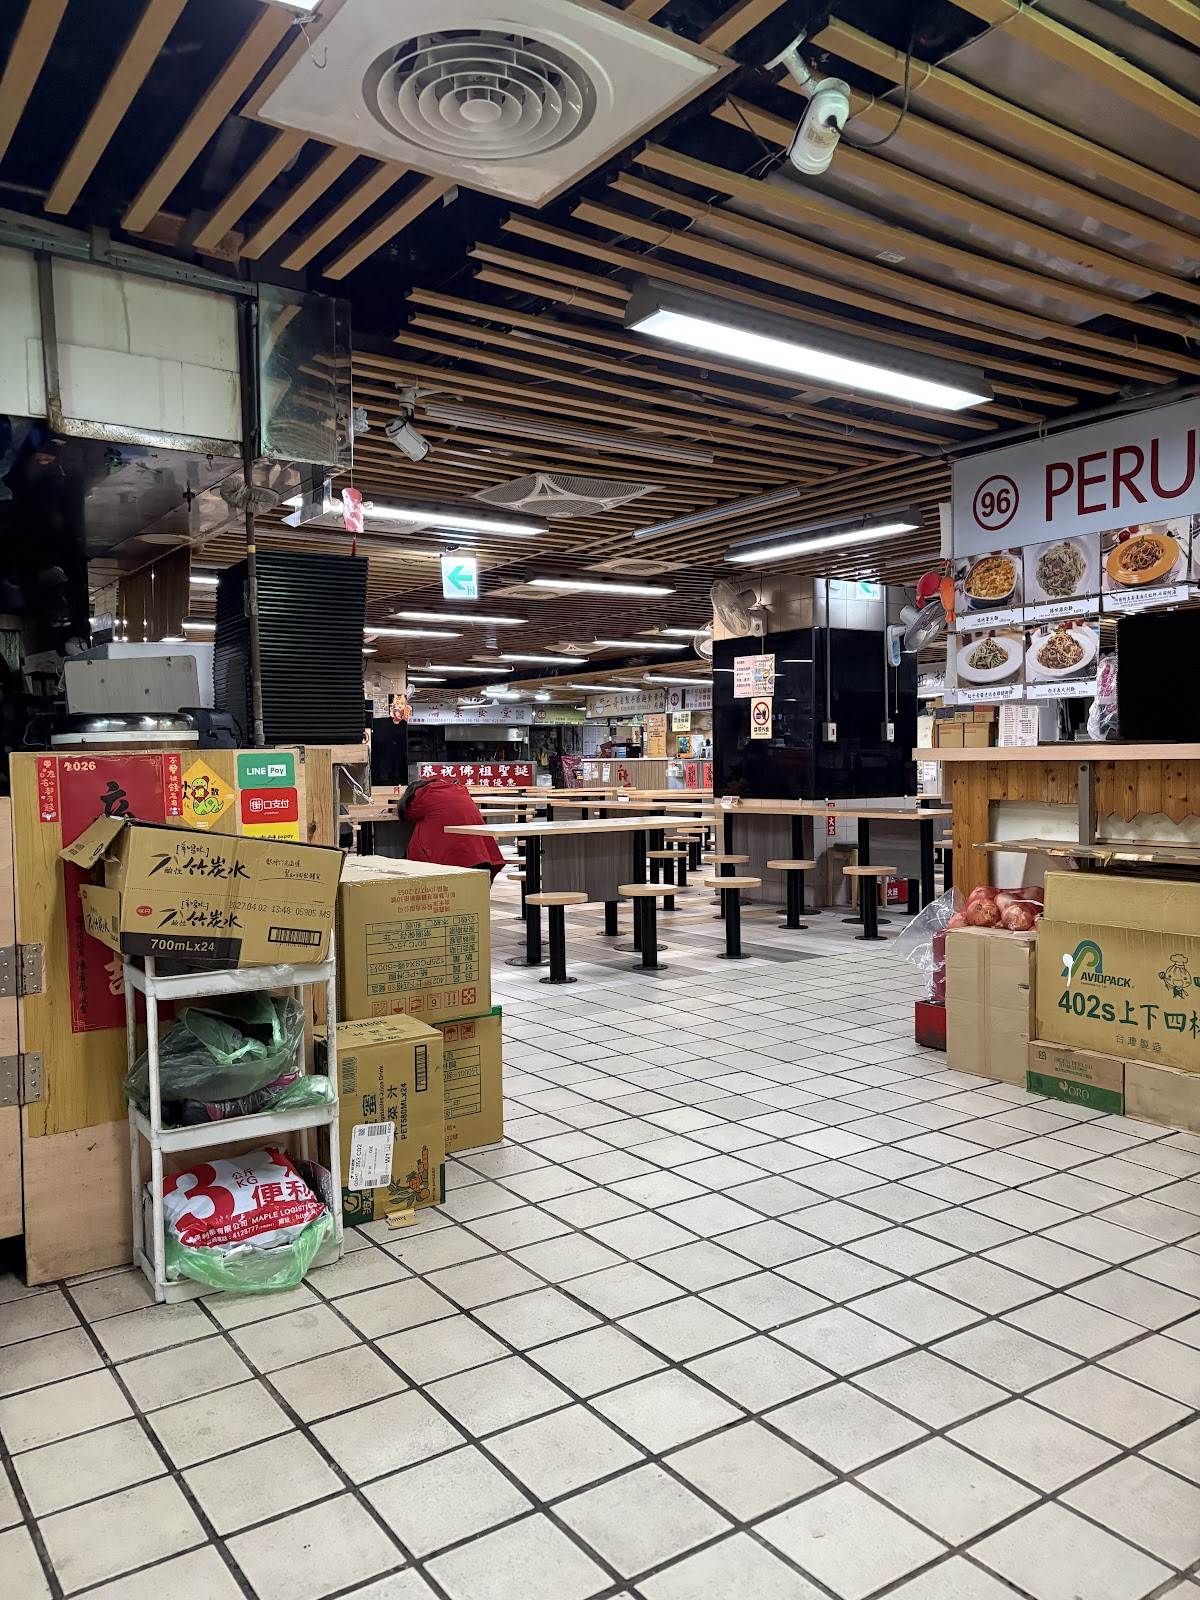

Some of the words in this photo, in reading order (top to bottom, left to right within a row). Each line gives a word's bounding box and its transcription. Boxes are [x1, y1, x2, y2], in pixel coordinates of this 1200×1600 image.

[981, 487, 1011, 518] 96
[64, 761, 97, 772] 2026
[246, 767, 266, 775] LINE
[270, 767, 284, 777] Pay
[422, 765, 530, 778] 恭祝佛祖聖誕
[250, 798, 289, 812] 街口支付
[183, 855, 251, 879] 竹炭水
[186, 909, 242, 929] 竹炭水
[151, 938, 215, 953] 700mLx24
[1116, 1034, 1161, 1051] 台灣製造
[1069, 1086, 1089, 1100] ORO
[400, 1082, 408, 1140] PET580MLx24
[232, 1168, 253, 1180] 公斤
[236, 1175, 258, 1188] KG
[251, 1211, 278, 1224] MAPLE
